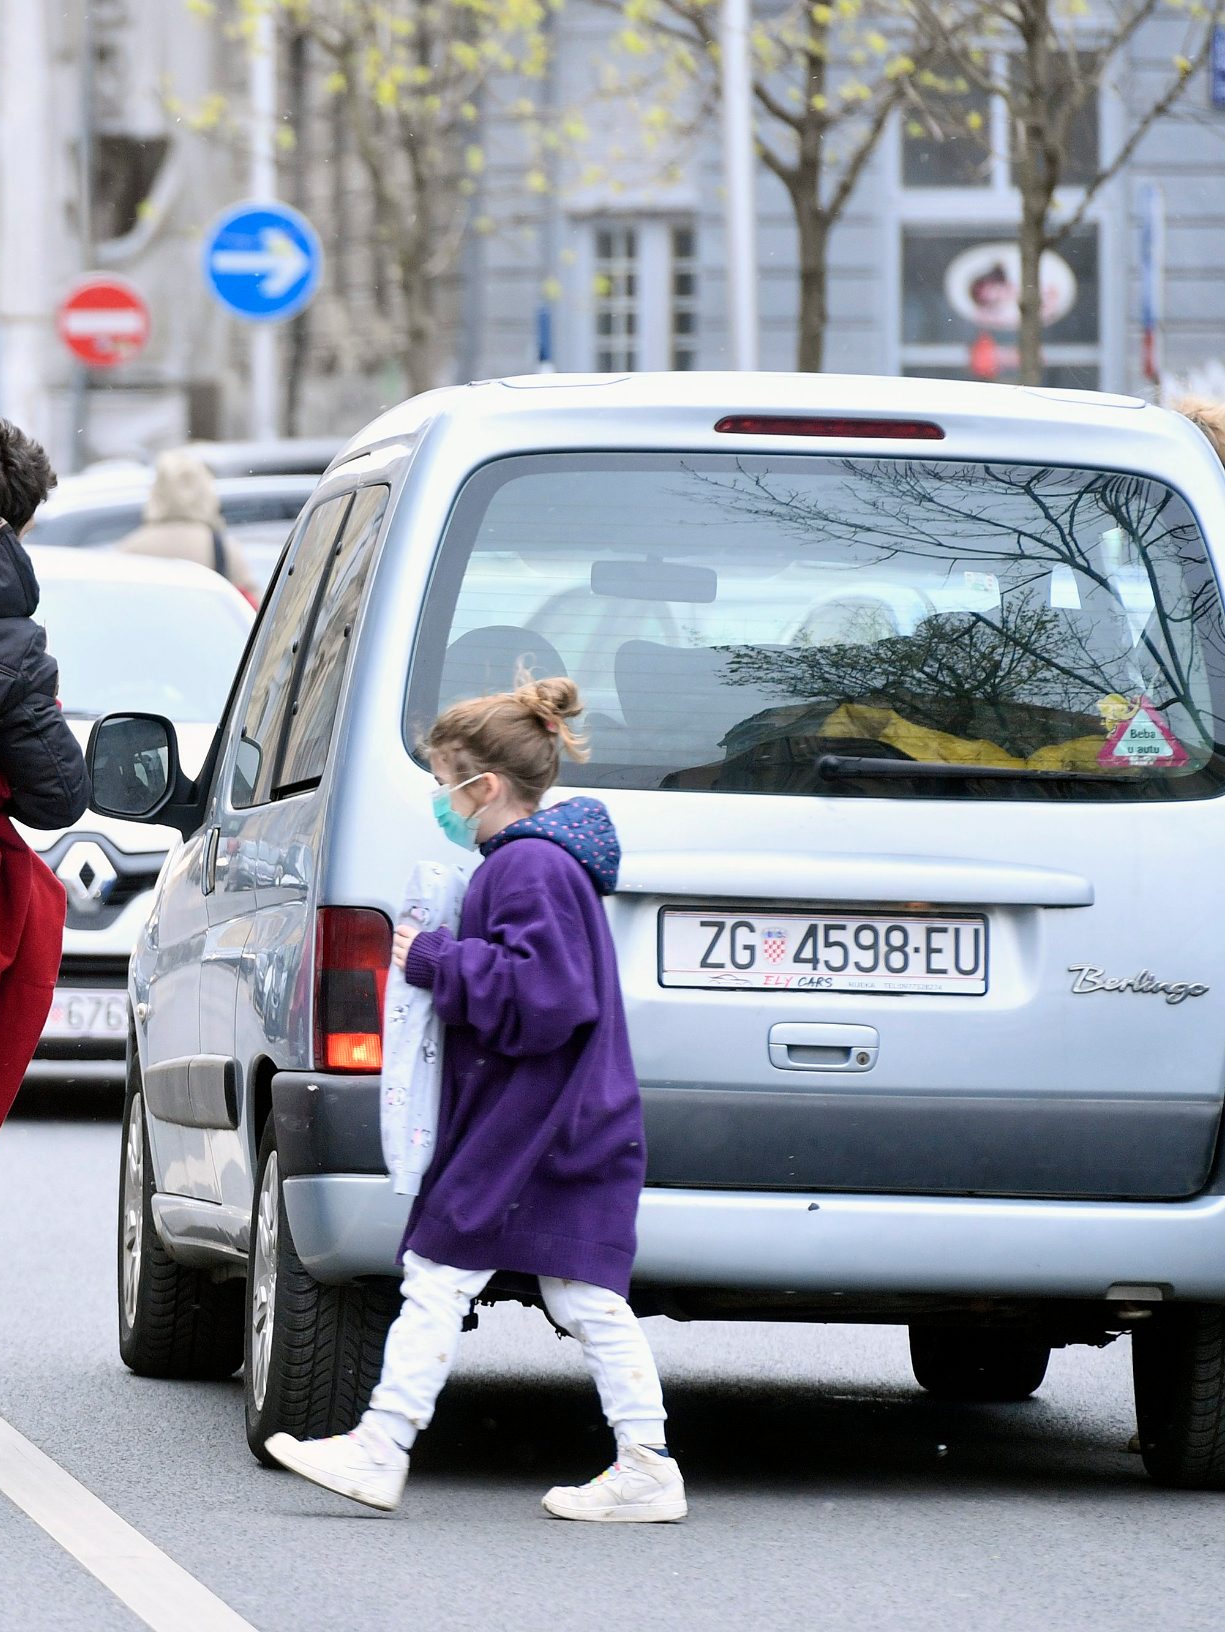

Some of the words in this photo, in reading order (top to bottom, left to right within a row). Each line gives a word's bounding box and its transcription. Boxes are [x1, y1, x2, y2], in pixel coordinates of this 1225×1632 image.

[1130, 729, 1156, 739] Beba
[1137, 746, 1160, 754] autu
[699, 920, 757, 970] ZG
[797, 976, 833, 988] CARS
[1067, 962, 1211, 1005] Berlingo
